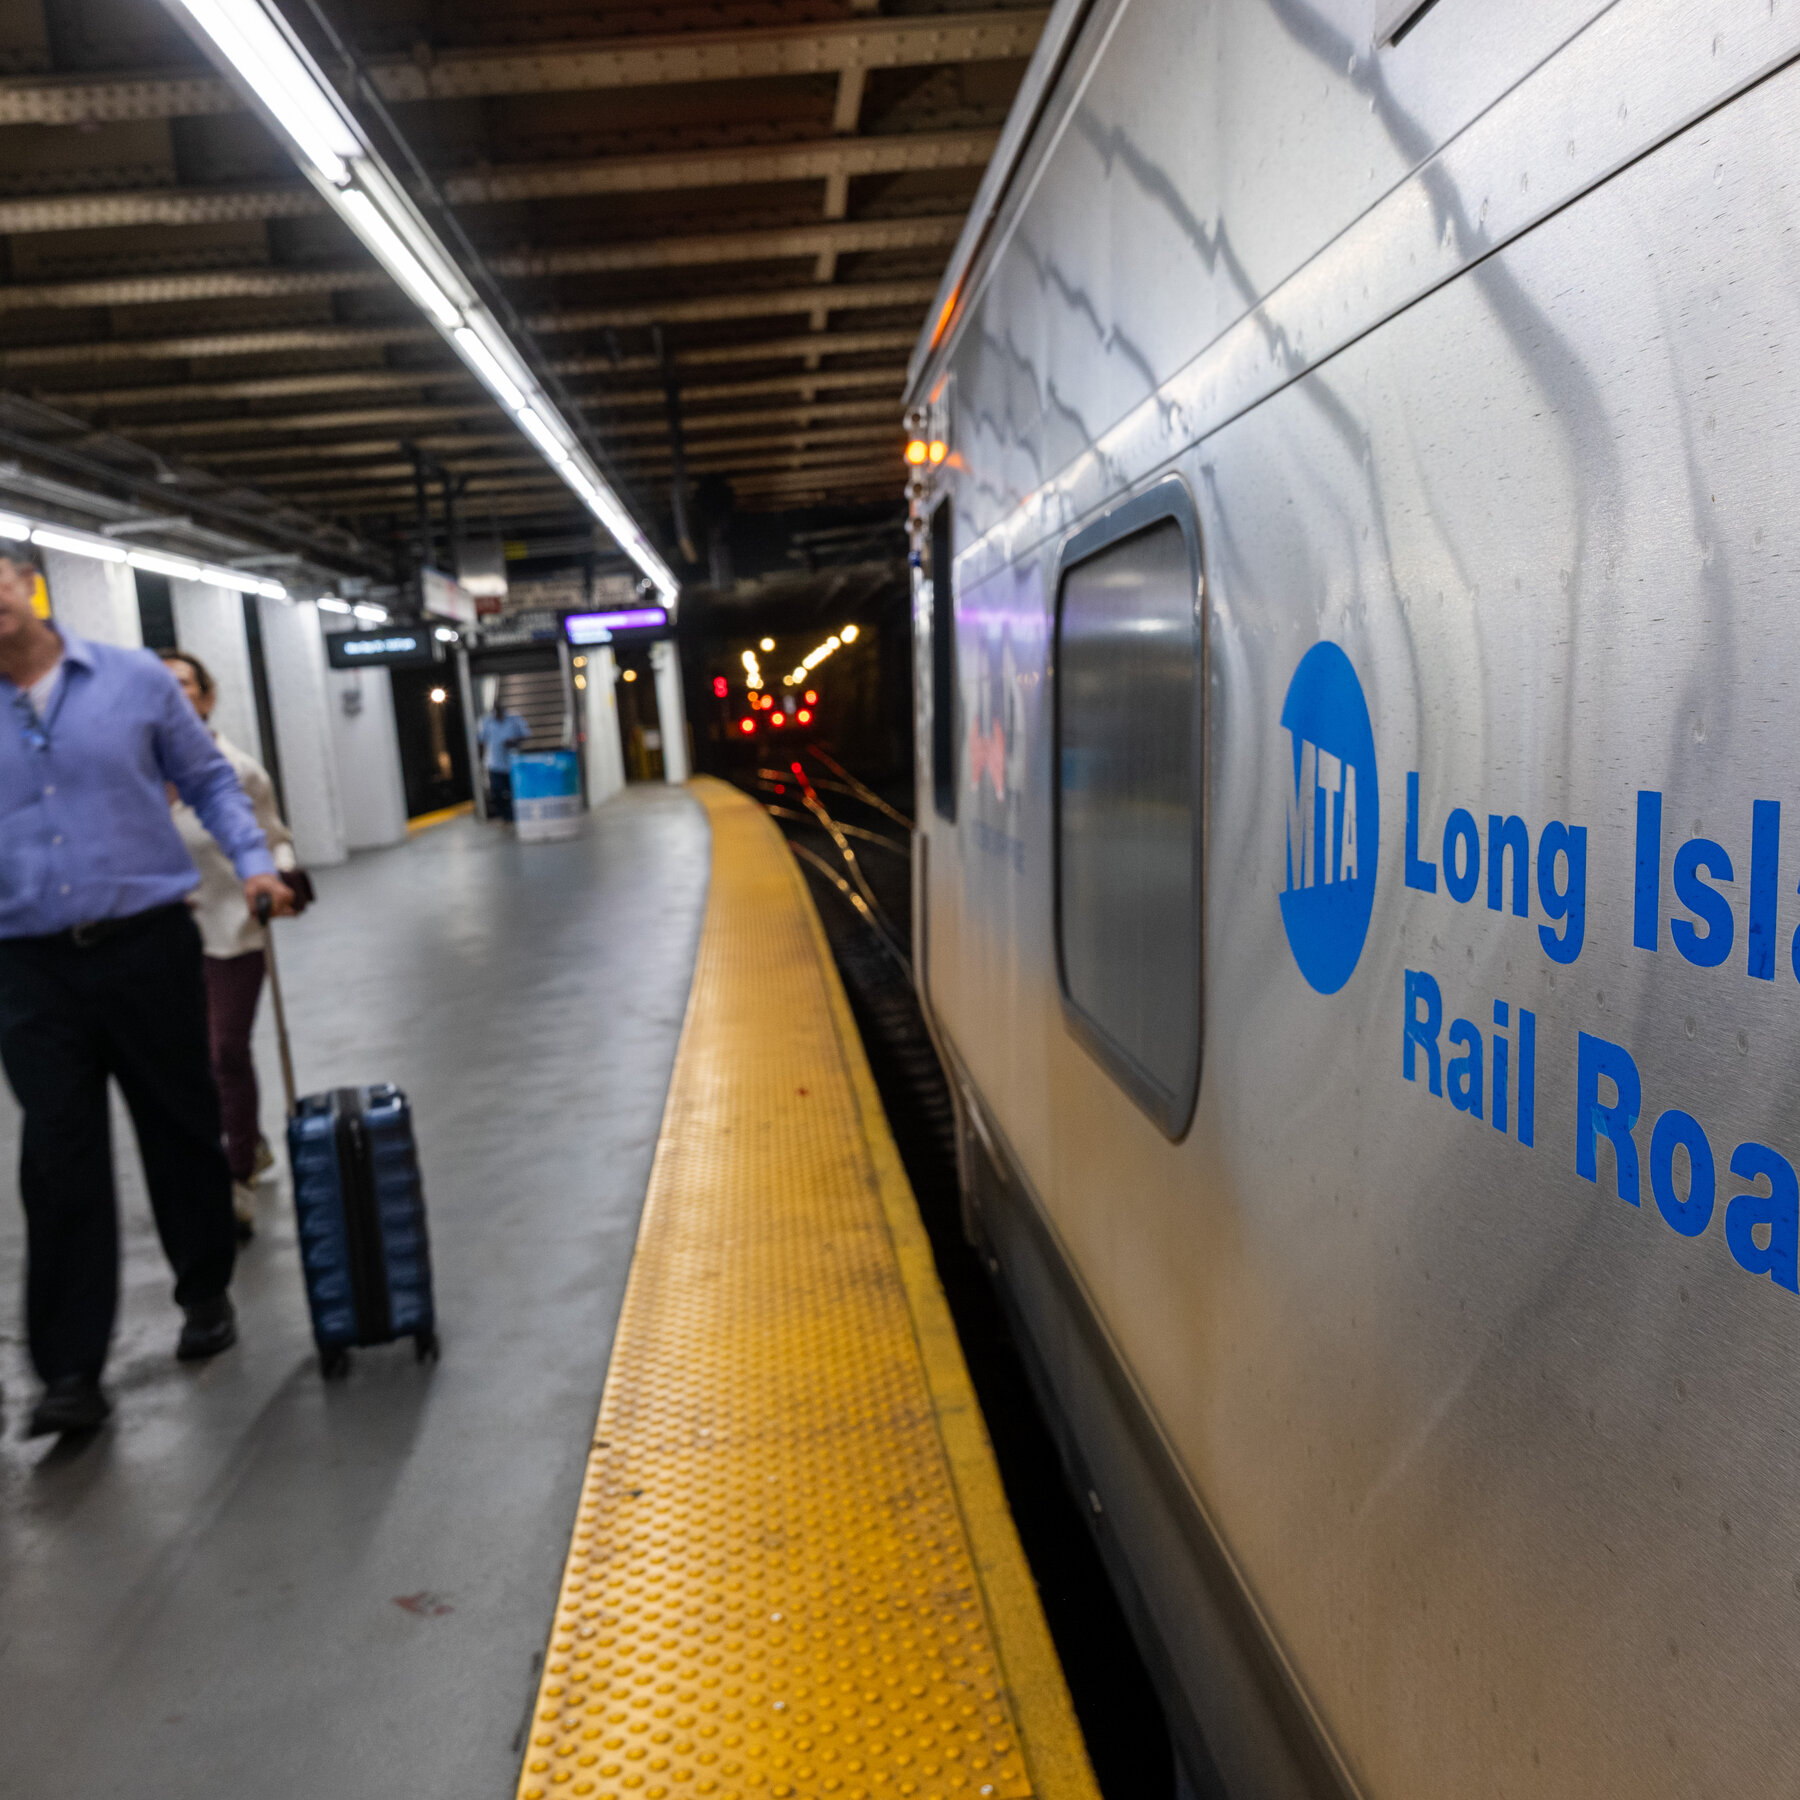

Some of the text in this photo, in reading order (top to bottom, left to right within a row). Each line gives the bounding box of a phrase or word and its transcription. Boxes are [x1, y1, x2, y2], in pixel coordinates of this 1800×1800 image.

[1280, 726, 1358, 892] MTA
[1404, 771, 1800, 985] Long Isl
[1403, 968, 1800, 1296] Rail Roa
